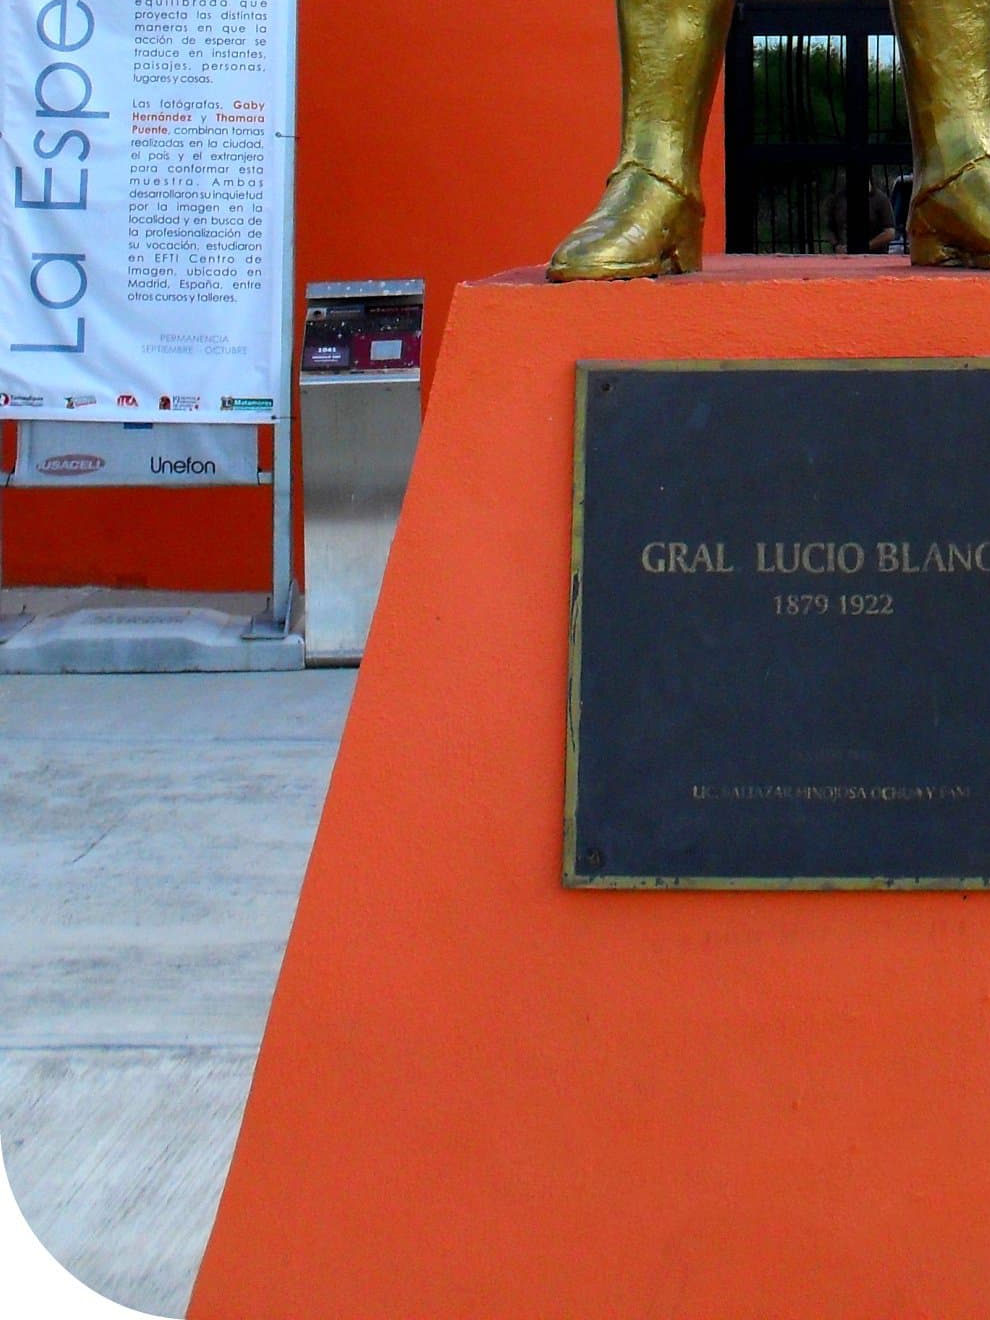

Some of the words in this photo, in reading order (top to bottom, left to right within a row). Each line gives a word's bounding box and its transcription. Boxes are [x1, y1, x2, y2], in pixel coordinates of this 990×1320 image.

[240, 0, 268, 9] que
[134, 11, 188, 20] proyecta
[196, 10, 212, 19] las
[221, 11, 267, 20] distintas
[134, 24, 188, 32] maneras
[197, 24, 213, 32] en
[222, 24, 246, 34] que
[255, 24, 267, 33] la
[134, 36, 173, 45] acción
[181, 36, 196, 45] de
[204, 37, 246, 47] esperar
[255, 38, 267, 46] se
[134, 48, 180, 58] traduce
[189, 50, 203, 58] en
[133, 73, 171, 84] lugares
[132, 99, 150, 109] Las
[233, 100, 265, 112] Gaby
[132, 111, 192, 122] Hernández
[216, 112, 265, 123] Thamara
[174, 126, 229, 135] combinan
[232, 127, 265, 136] tomas
[131, 139, 184, 148] realizadas
[189, 140, 203, 148] en
[207, 139, 218, 148] la
[131, 151, 140, 160] el
[148, 151, 170, 161] país
[192, 152, 202, 161] el
[210, 152, 264, 163] extranjero
[130, 164, 158, 174] para
[167, 164, 230, 174] conformar
[239, 165, 264, 174] esta
[211, 178, 264, 187] Ambas
[129, 189, 198, 199] desarrollaron
[200, 191, 211, 200] su
[212, 190, 263, 200] inquietud
[129, 203, 149, 213] por
[157, 202, 168, 212] la
[176, 203, 220, 214] imagen
[228, 204, 244, 213] en
[252, 203, 263, 213] la
[128, 215, 180, 225] localidad
[193, 217, 207, 225] en
[211, 216, 244, 226] busca
[247, 216, 262, 226] de
[128, 227, 139, 237] la
[145, 227, 241, 238] profesionalización
[247, 229, 262, 239] de
[128, 241, 140, 250] su
[206, 241, 262, 251] estudiaron
[128, 254, 144, 263] en
[155, 253, 179, 263] EFTI
[189, 254, 235, 264] Centro
[245, 255, 262, 264] de
[186, 266, 238, 277] ubicado
[247, 268, 262, 277] en
[232, 280, 261, 290] entre
[127, 292, 154, 301] otros
[155, 294, 188, 302] cursos
[10, 253, 88, 353] La
[150, 456, 216, 474] Unefon
[641, 541, 734, 573] GRAL
[755, 541, 865, 573] LUCIO
[772, 594, 829, 616] 1879
[838, 594, 894, 616] 1922
